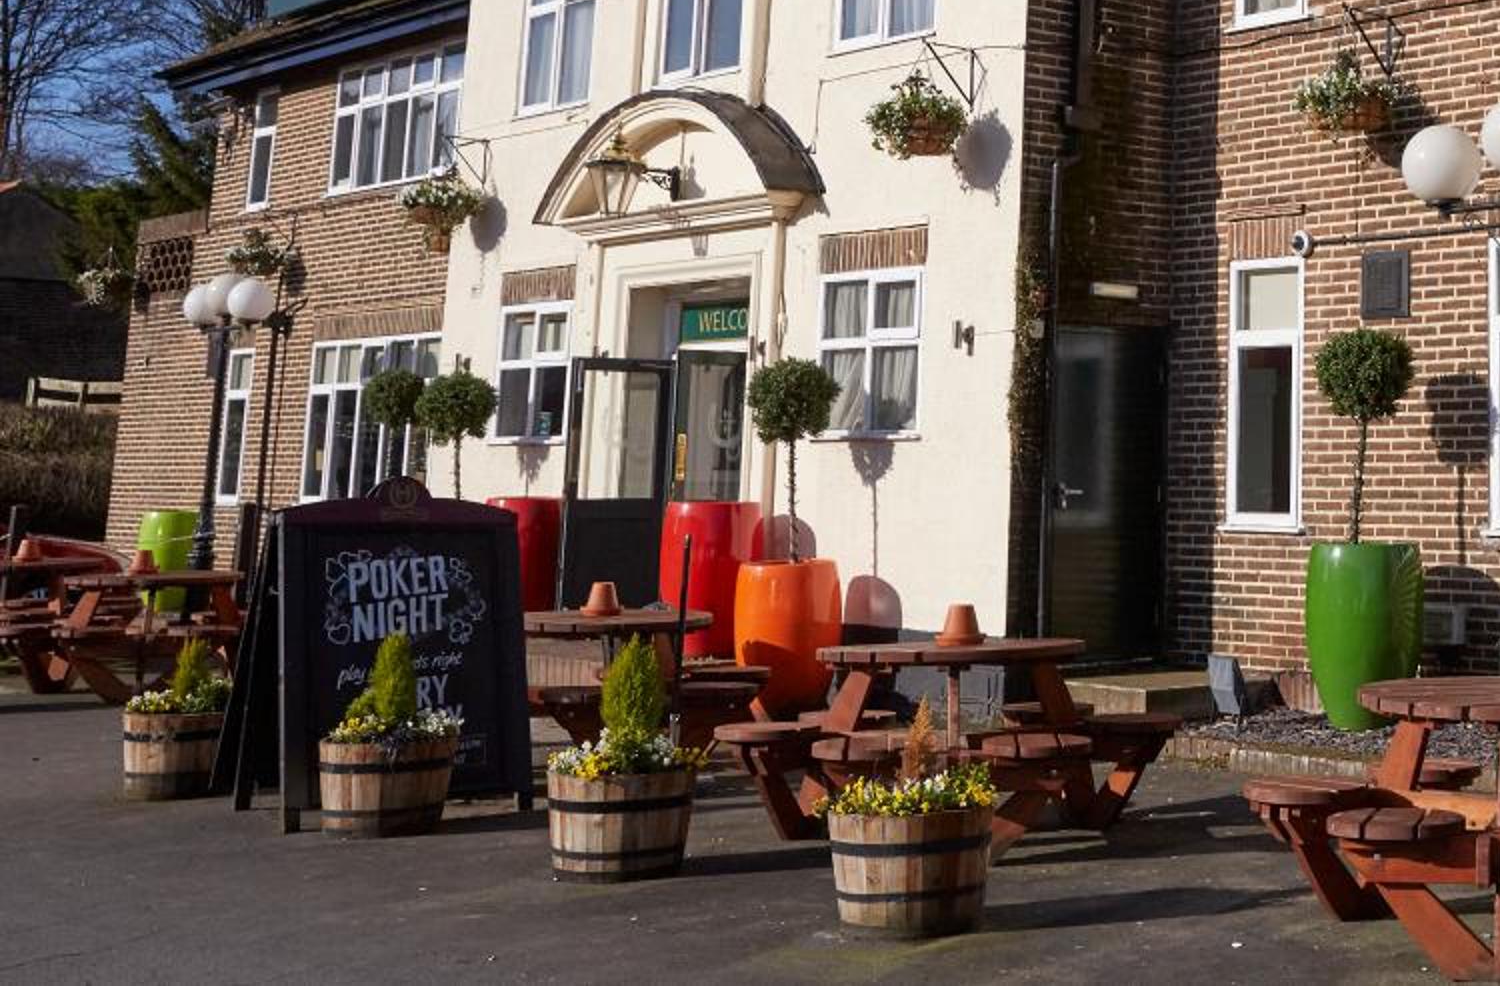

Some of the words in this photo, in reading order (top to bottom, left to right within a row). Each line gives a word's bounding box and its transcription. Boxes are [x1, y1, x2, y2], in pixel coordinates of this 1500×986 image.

[699, 307, 748, 333] WELCO
[348, 555, 449, 602] POKER
[352, 593, 449, 643] NIGHT
